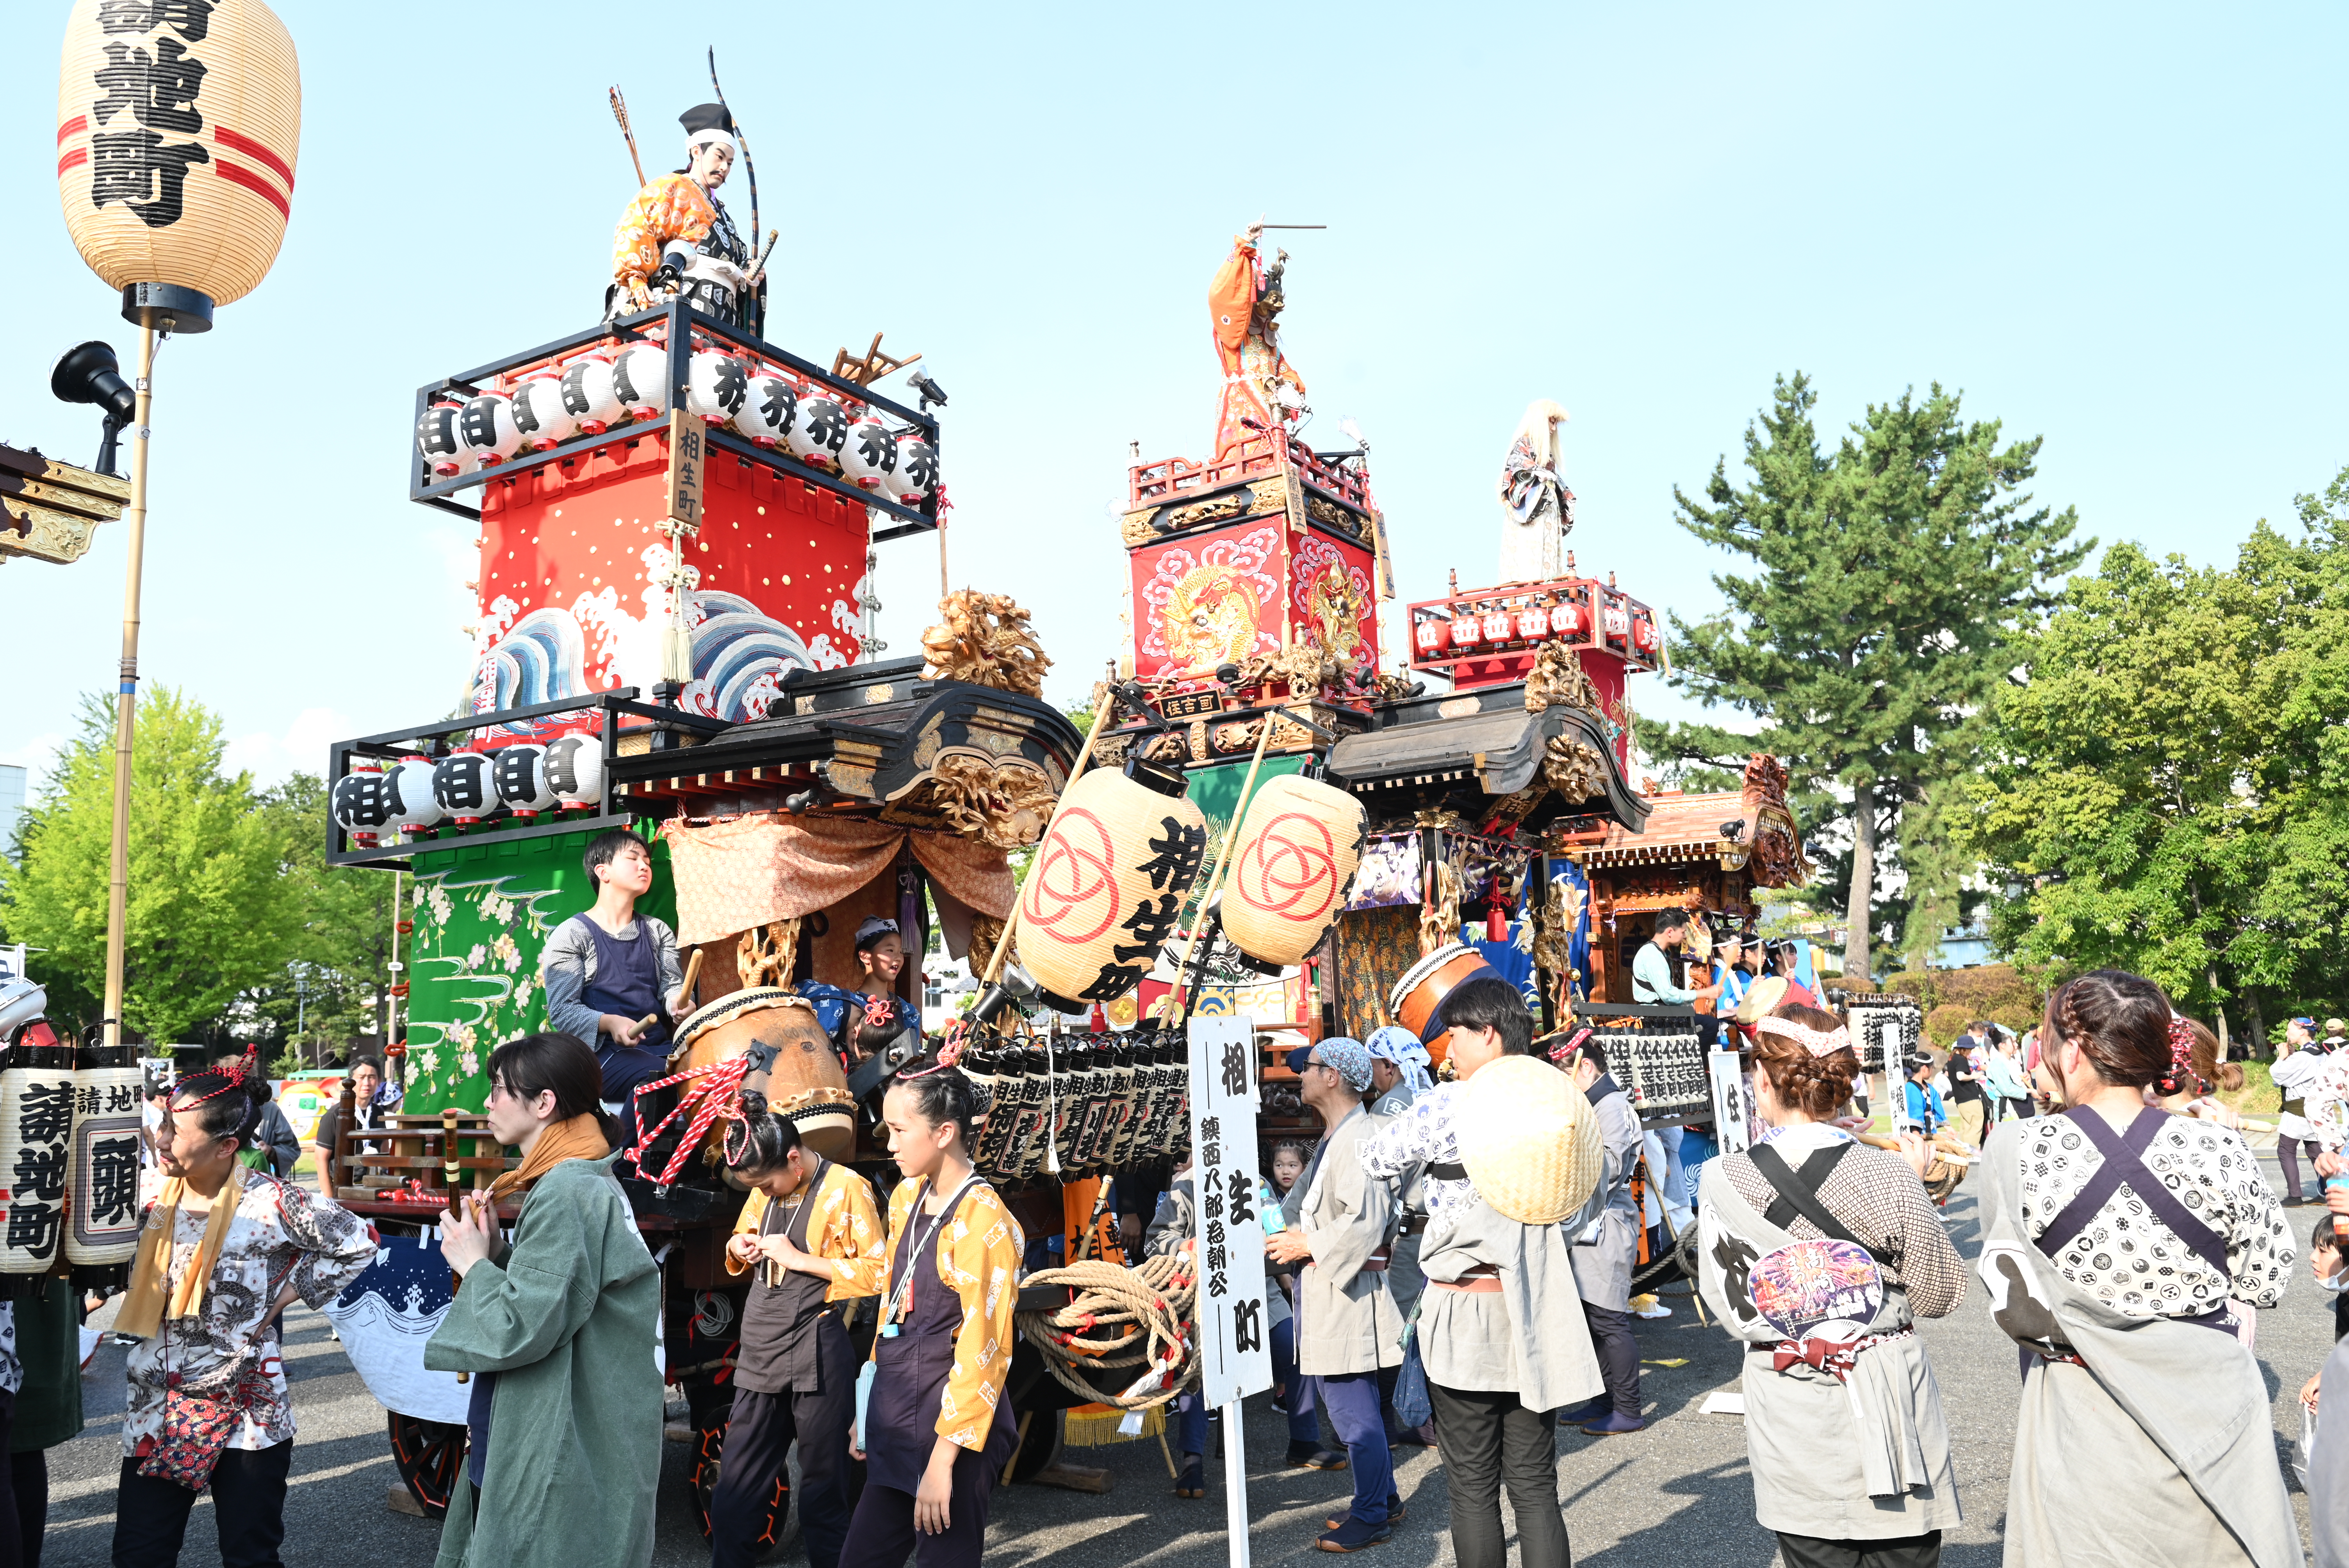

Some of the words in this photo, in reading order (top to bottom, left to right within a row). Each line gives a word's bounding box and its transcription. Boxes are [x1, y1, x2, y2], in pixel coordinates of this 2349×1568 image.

[678, 428, 700, 519] 相生町
[1287, 470, 1306, 528] 蘭陵王
[1377, 520, 1394, 592] 第二番
[1451, 618, 1480, 643] 並
[1483, 613, 1511, 640] 並
[1519, 610, 1548, 637] 並
[1166, 695, 1214, 716] 住吉町
[335, 776, 387, 827] 相
[6, 1081, 76, 1260] 請地町
[91, 1135, 138, 1226] 頭
[1221, 1041, 1261, 1354] 相生町
